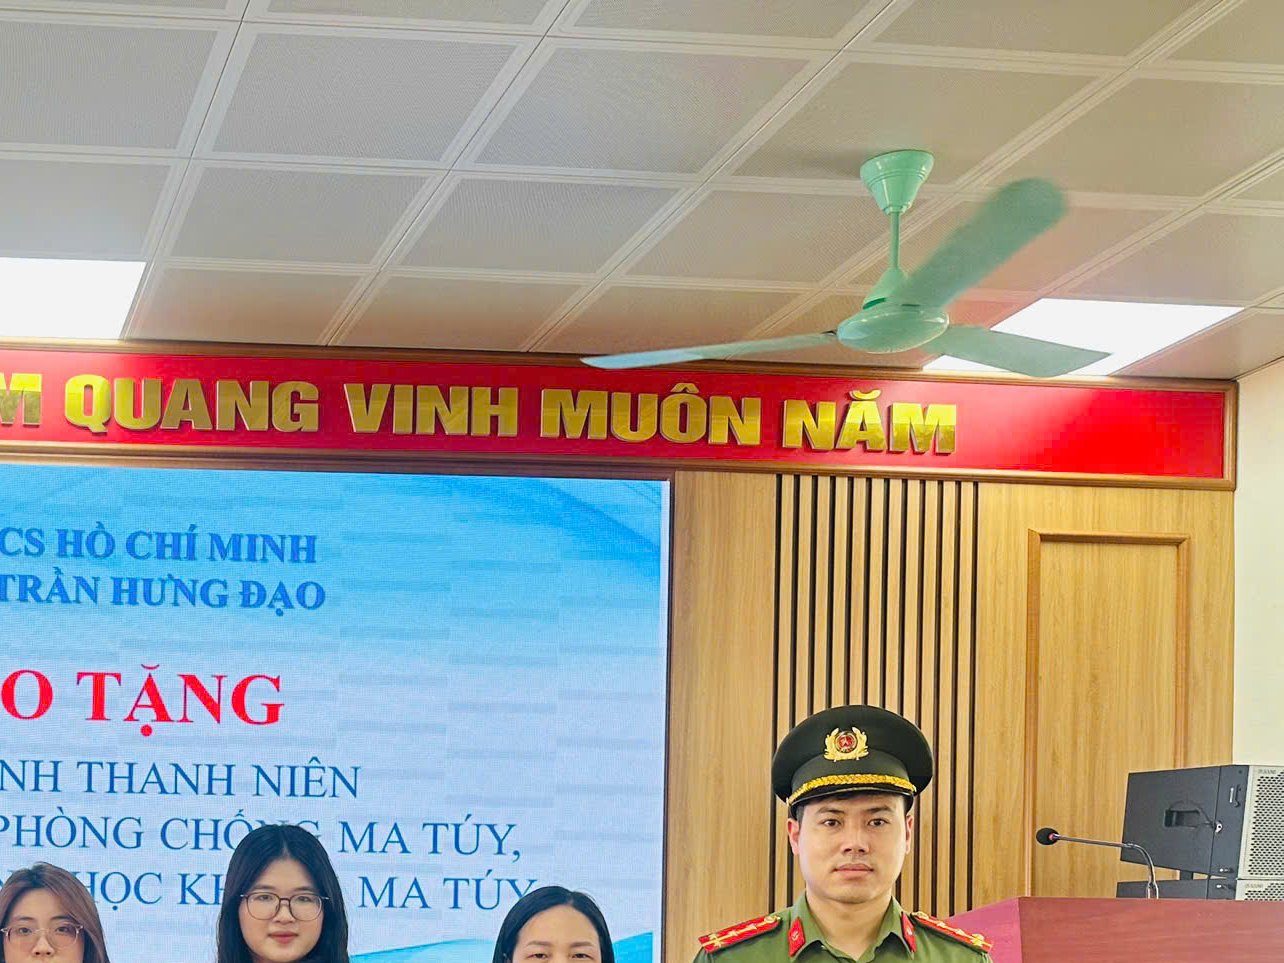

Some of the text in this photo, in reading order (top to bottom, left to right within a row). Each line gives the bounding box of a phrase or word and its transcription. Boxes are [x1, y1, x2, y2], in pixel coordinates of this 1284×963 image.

[63, 372, 320, 435] QUANG
[343, 381, 517, 439] VINH
[540, 379, 760, 447] MUÔN
[781, 387, 957, 455] NĂM
[57, 516, 116, 561] HỒ
[125, 521, 200, 562] CHÍ
[208, 532, 317, 564] MINH
[112, 575, 230, 610] HƯNG
[240, 580, 326, 618] ĐẠO
[77, 663, 285, 737] TẶNG
[77, 760, 236, 797] THANH
[252, 756, 361, 798] NIÊN
[337, 820, 412, 854] MA
[423, 813, 521, 862] TÚY,
[358, 876, 432, 909] MA
